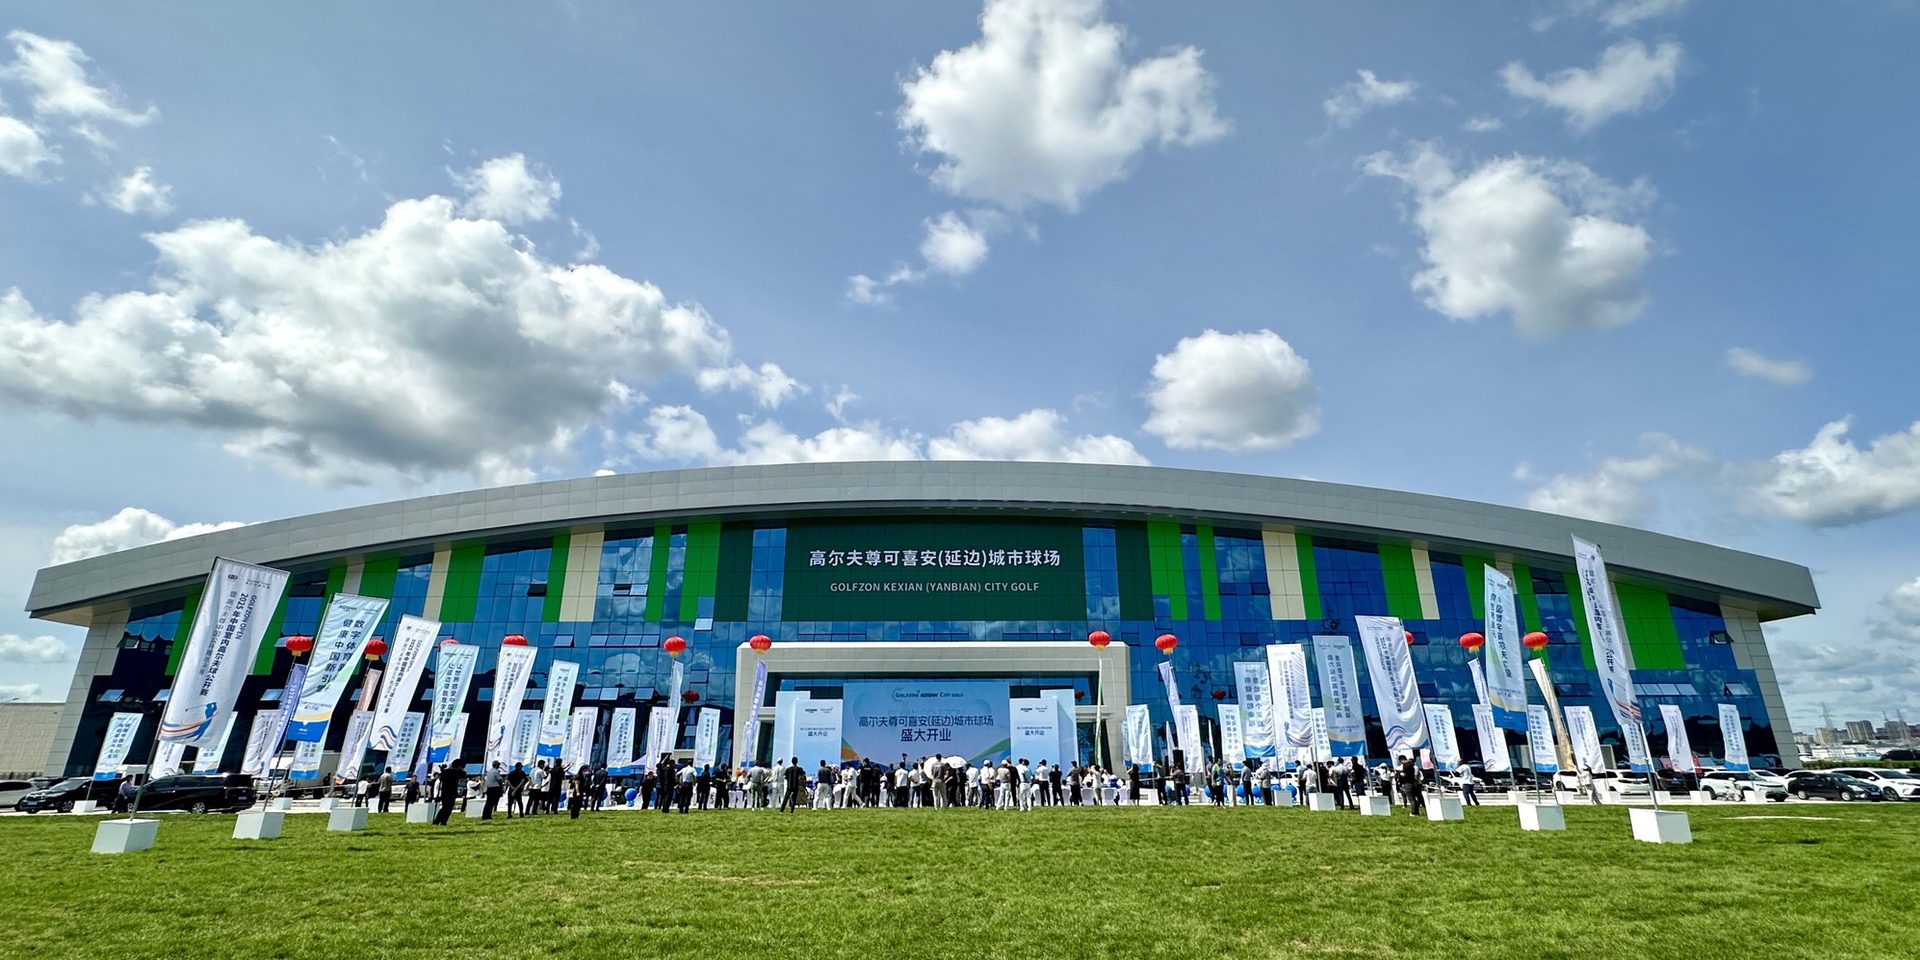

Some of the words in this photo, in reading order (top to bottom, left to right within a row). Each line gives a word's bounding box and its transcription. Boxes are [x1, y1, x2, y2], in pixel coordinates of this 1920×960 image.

[809, 549, 1061, 568] 高尔夫尊可喜安(延边)城市球场
[830, 582, 881, 593] GOLFZON
[883, 582, 923, 593] KEXIAN
[926, 581, 981, 594] (YANBIAN)
[984, 582, 1009, 593] CITY
[1011, 582, 1040, 593] GOLF
[858, 715, 994, 727] 高尔夫尊可喜安(延边)城市球场
[900, 728, 952, 742] 盛大开业
